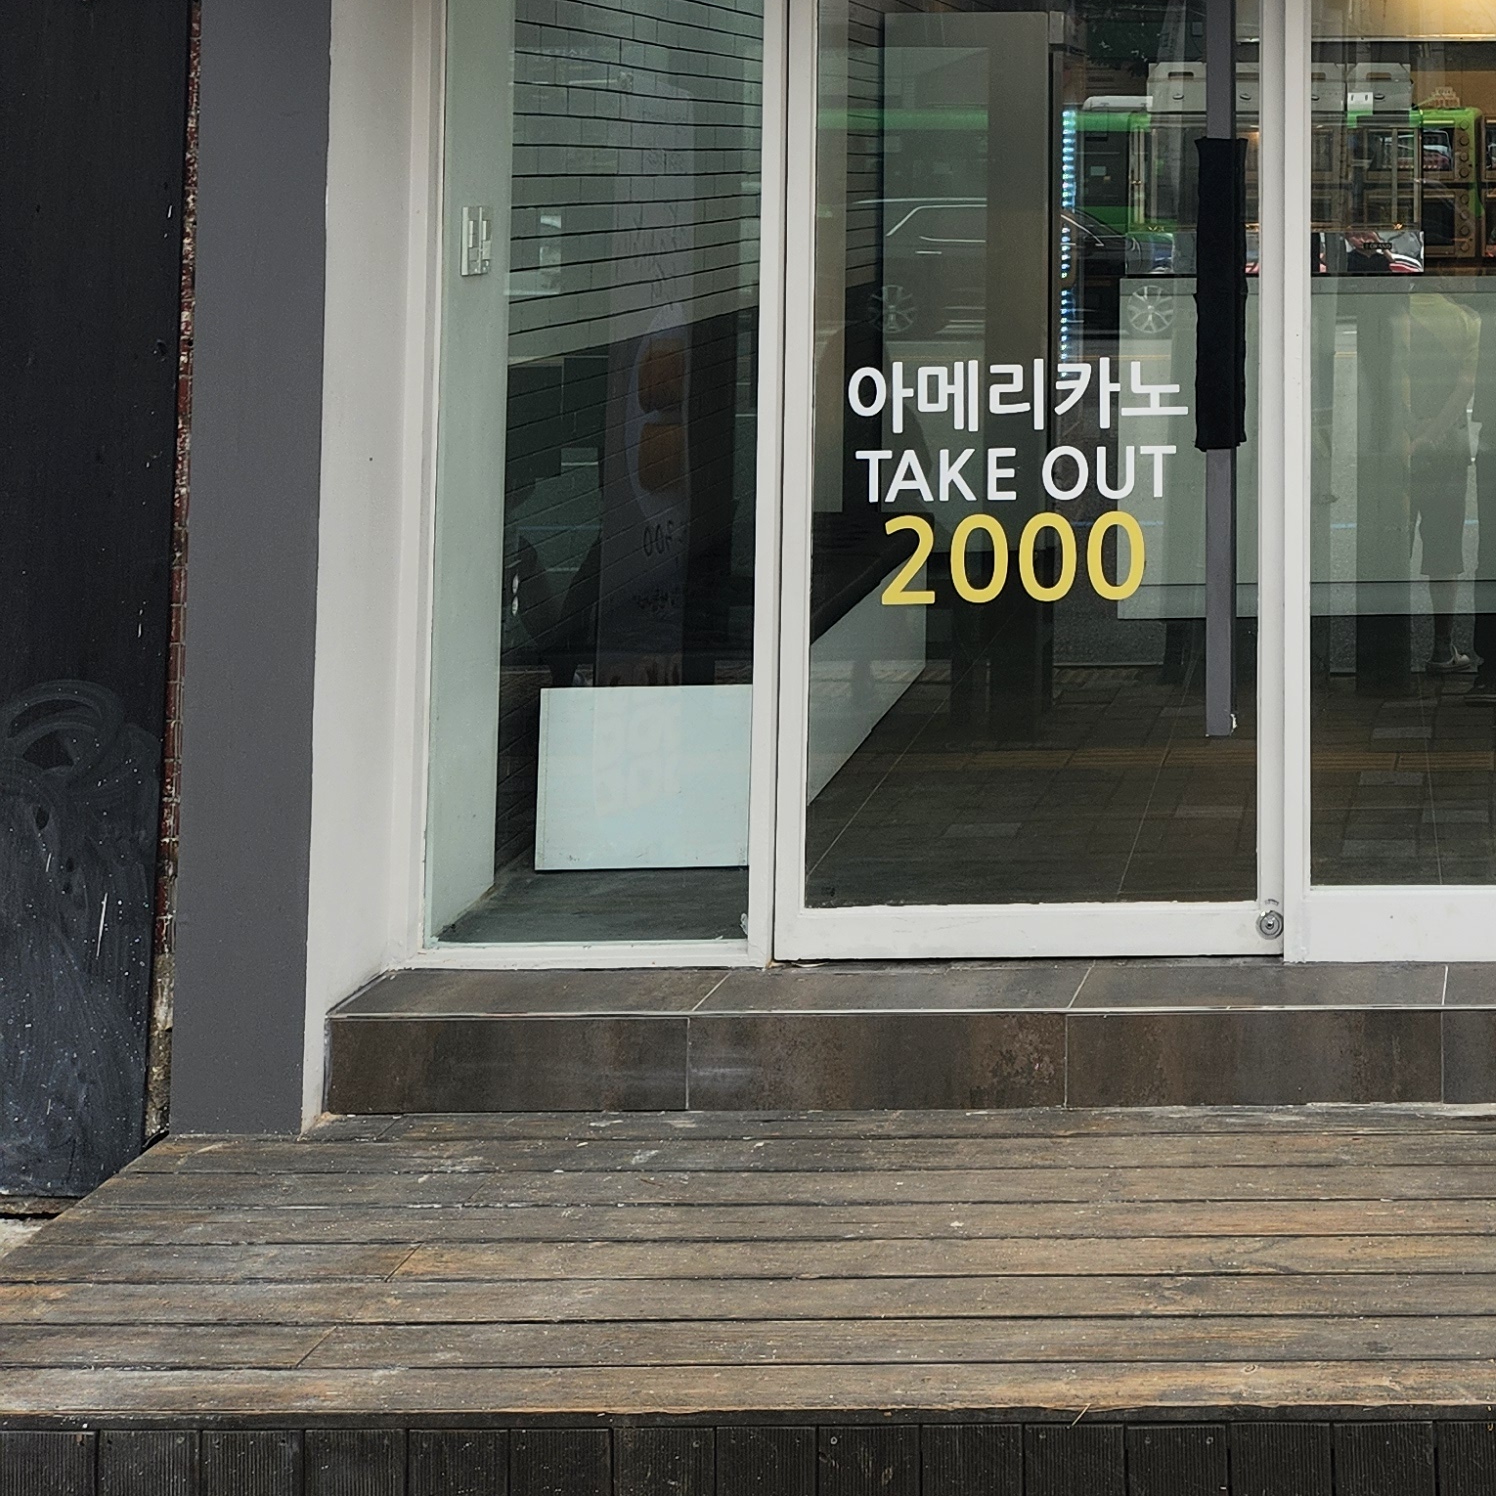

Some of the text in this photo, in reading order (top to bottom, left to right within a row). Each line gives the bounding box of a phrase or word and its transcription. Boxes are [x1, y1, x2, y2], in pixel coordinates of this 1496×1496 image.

[848, 356, 1189, 434] 아메리카노
[855, 445, 1177, 503] TAKE OUT
[881, 510, 1146, 605] 2000
